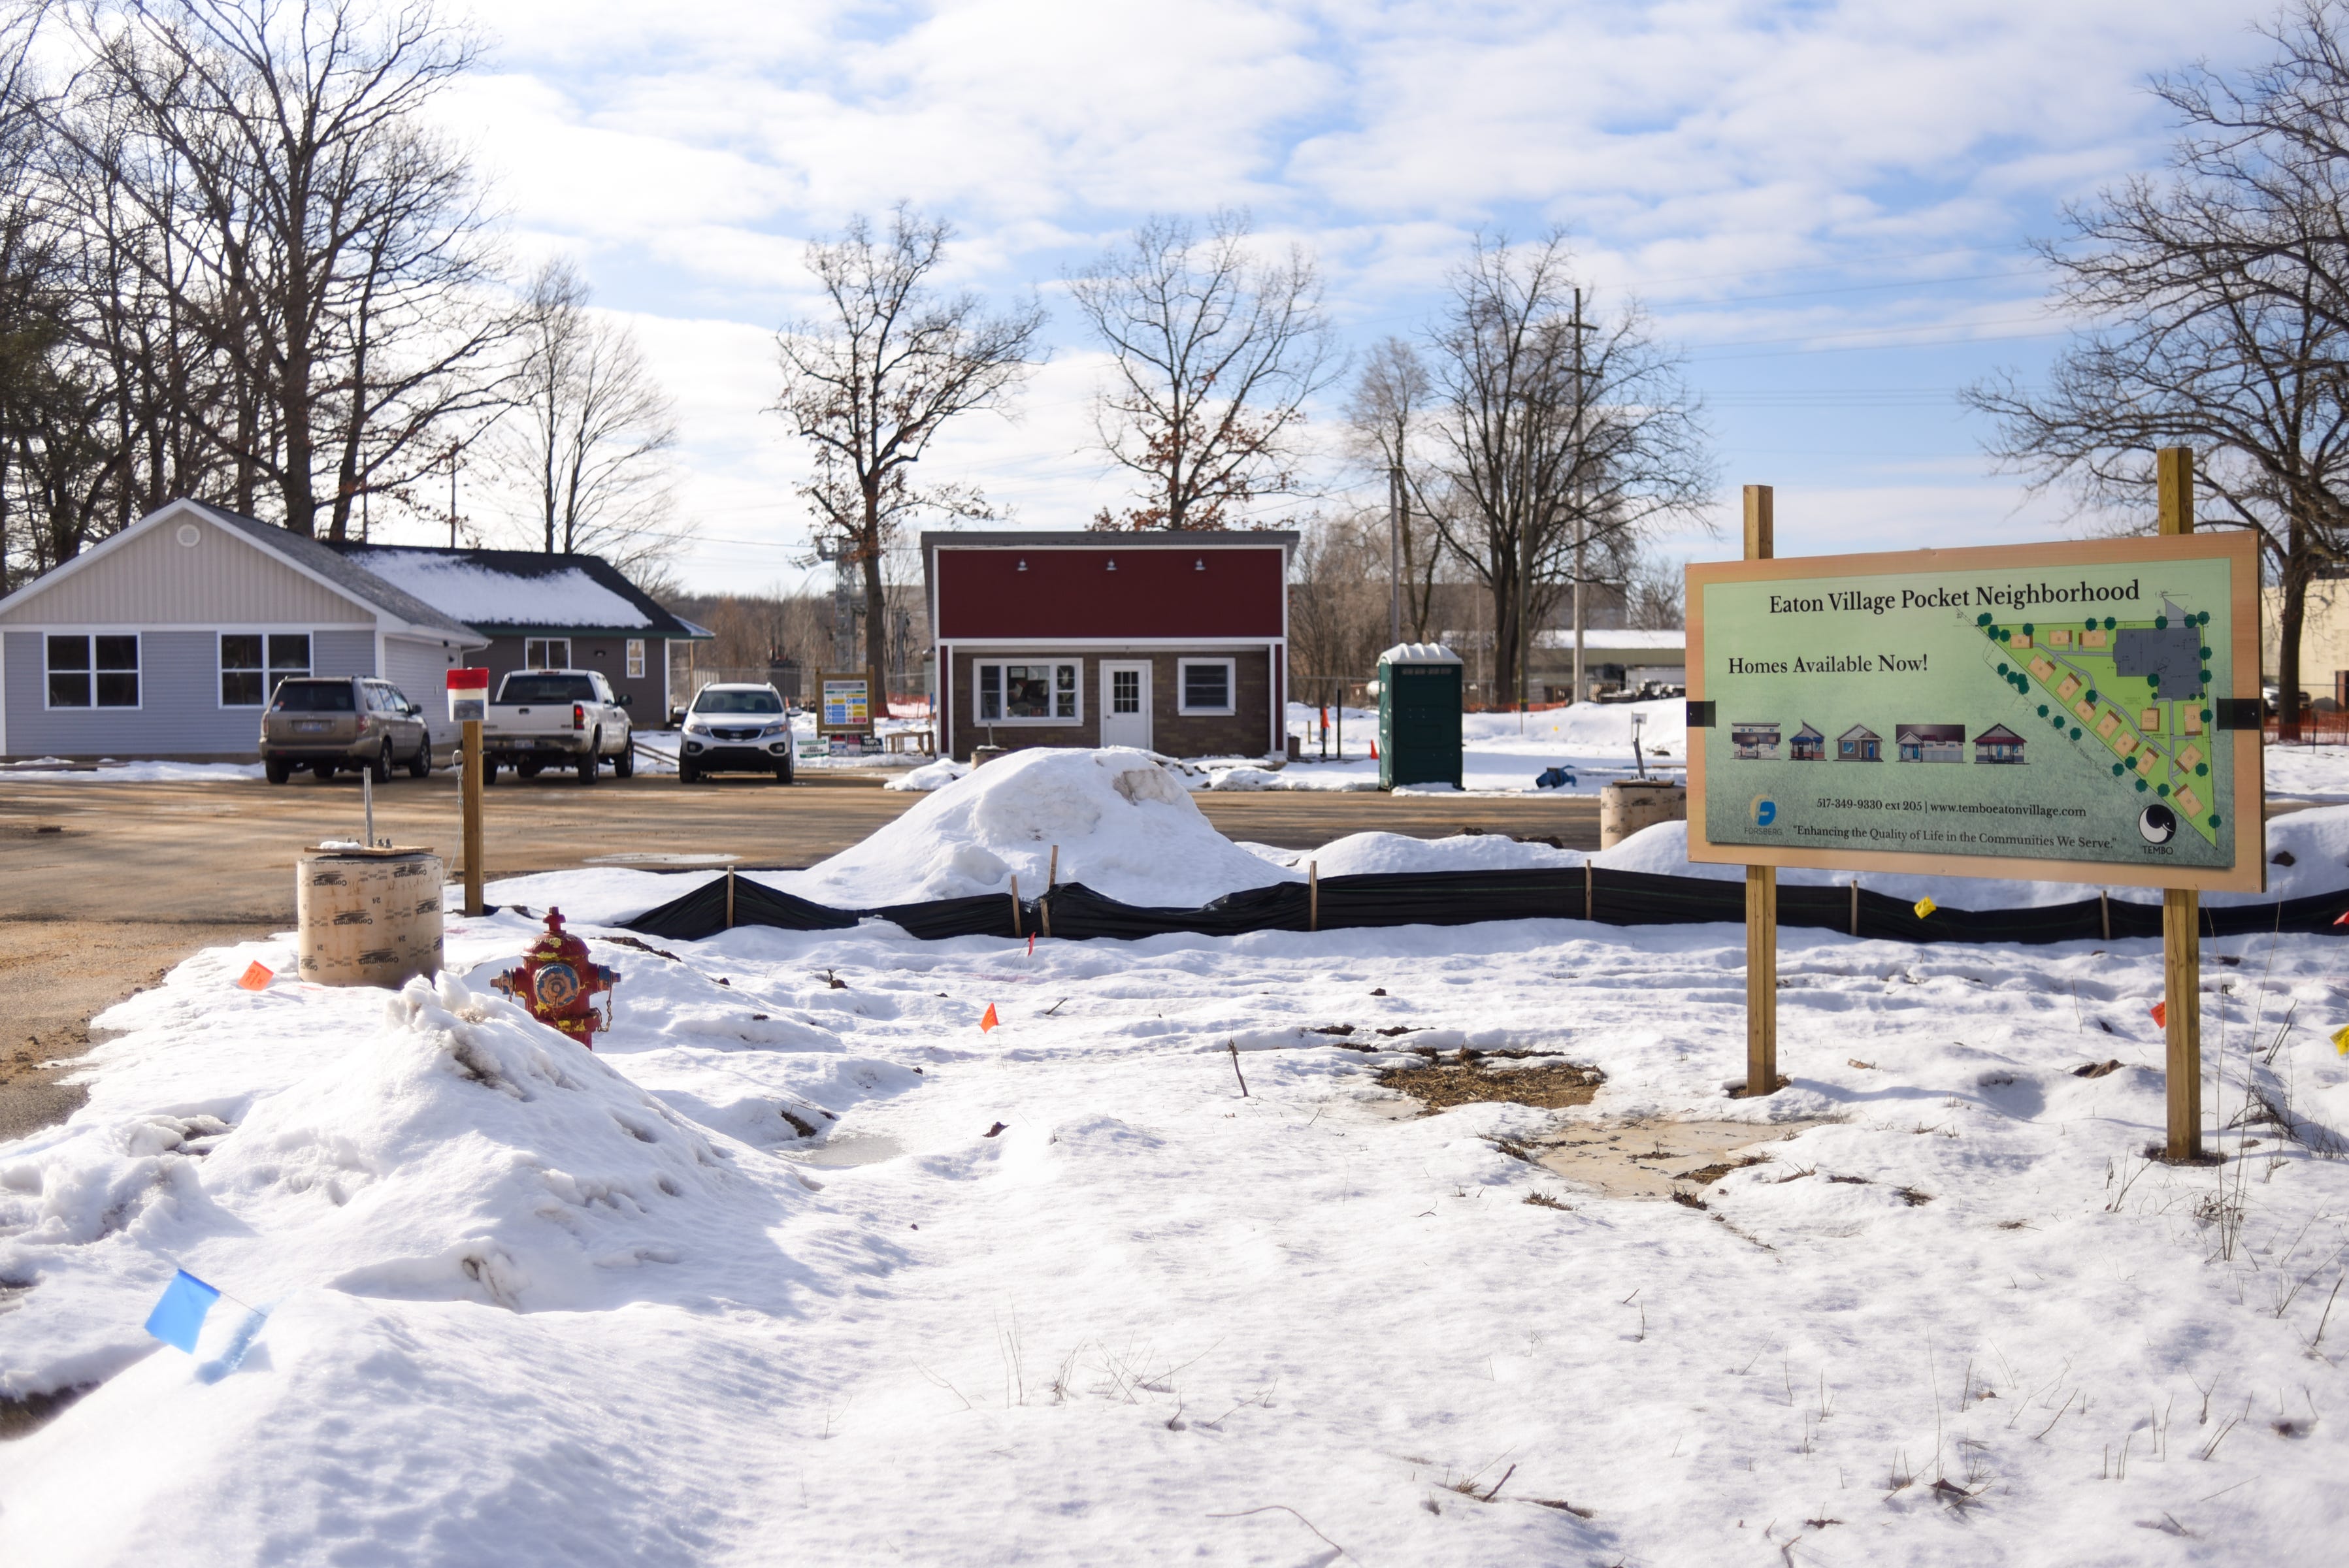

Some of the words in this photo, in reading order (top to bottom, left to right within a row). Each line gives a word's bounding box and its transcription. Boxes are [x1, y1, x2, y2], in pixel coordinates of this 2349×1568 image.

[1769, 595, 1824, 613] Eaton
[1828, 591, 1896, 615] Village
[1901, 587, 1970, 608] Pocket
[1975, 579, 2140, 610] Neighborhood
[1728, 657, 1788, 674] Homes
[1792, 655, 1873, 673] Available
[1878, 653, 1928, 672] Now!
[1816, 798, 1882, 810] 517-349-9330
[1885, 801, 1901, 810] ext
[1903, 800, 1922, 811] 205
[1930, 803, 2086, 817] www.temboeatonvillage.com
[1744, 827, 1782, 836] FORSBERG
[1852, 827, 1867, 838] the
[1869, 828, 1908, 841] Quality
[1910, 831, 1921, 840] of
[1923, 830, 1943, 841] Life
[1947, 831, 1956, 841] in
[1960, 832, 1977, 843] the
[1979, 832, 2054, 847] Communities
[2057, 836, 2075, 847] We
[2142, 845, 2173, 855] TEMBO
[393, 869, 427, 878] Consumers
[358, 956, 399, 965] Consumers
